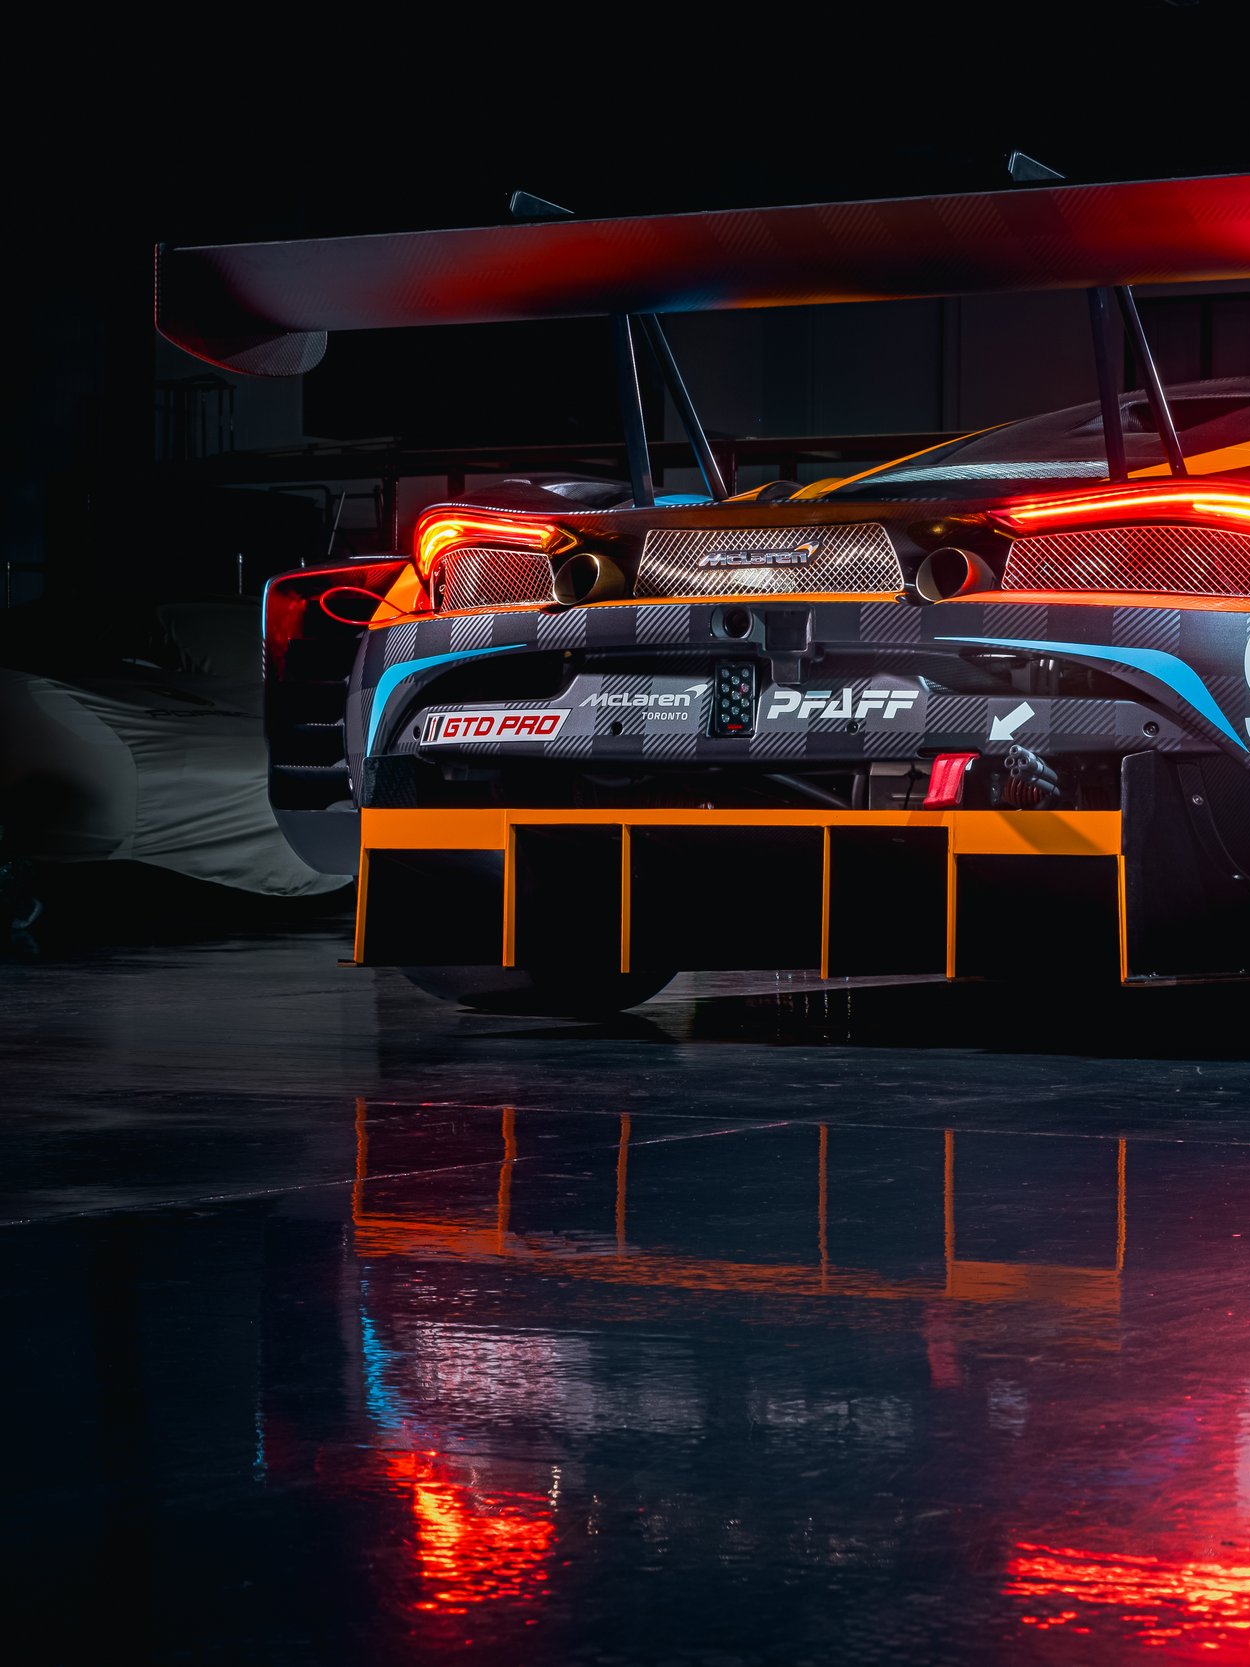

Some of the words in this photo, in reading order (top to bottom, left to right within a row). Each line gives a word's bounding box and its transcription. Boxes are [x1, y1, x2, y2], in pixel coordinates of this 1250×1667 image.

[699, 551, 807, 567] McLaren
[579, 692, 691, 708] McLaren
[767, 688, 919, 719] PFAFF
[642, 712, 688, 721] TORONTO
[443, 717, 494, 738] GTD
[499, 715, 560, 737] PRO
